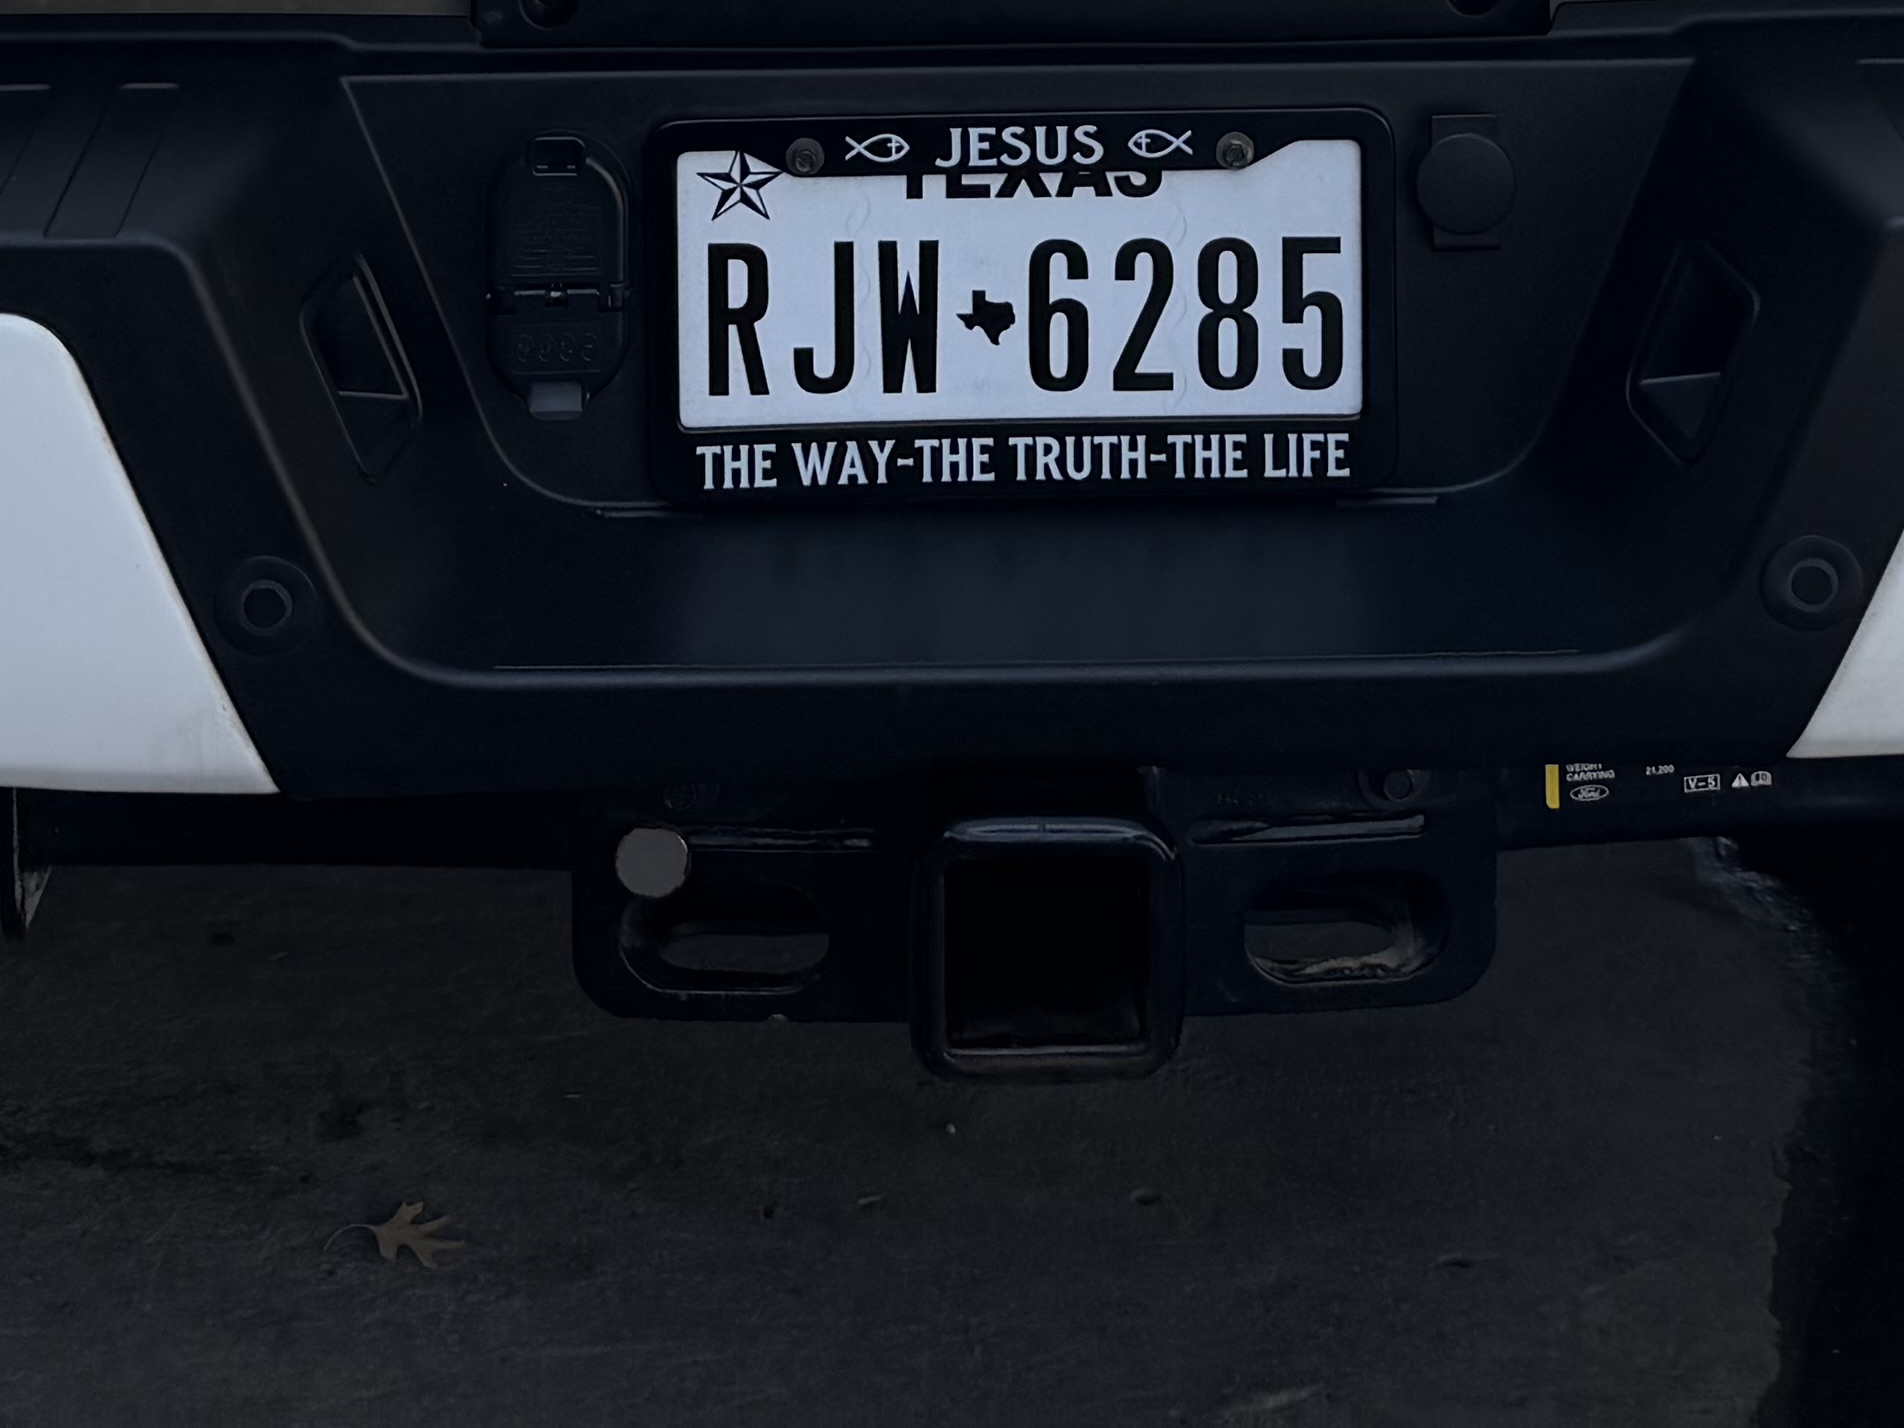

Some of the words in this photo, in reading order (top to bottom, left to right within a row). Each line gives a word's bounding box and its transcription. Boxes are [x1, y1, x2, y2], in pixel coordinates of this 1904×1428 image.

[935, 125, 1105, 169] JESUS
[707, 238, 940, 397] RJW
[1027, 235, 1344, 395] 6285
[696, 443, 777, 490] THE
[791, 437, 996, 486] WAY-THE
[1008, 434, 1247, 482] TRUTH-THE
[1262, 433, 1351, 479] LIFE
